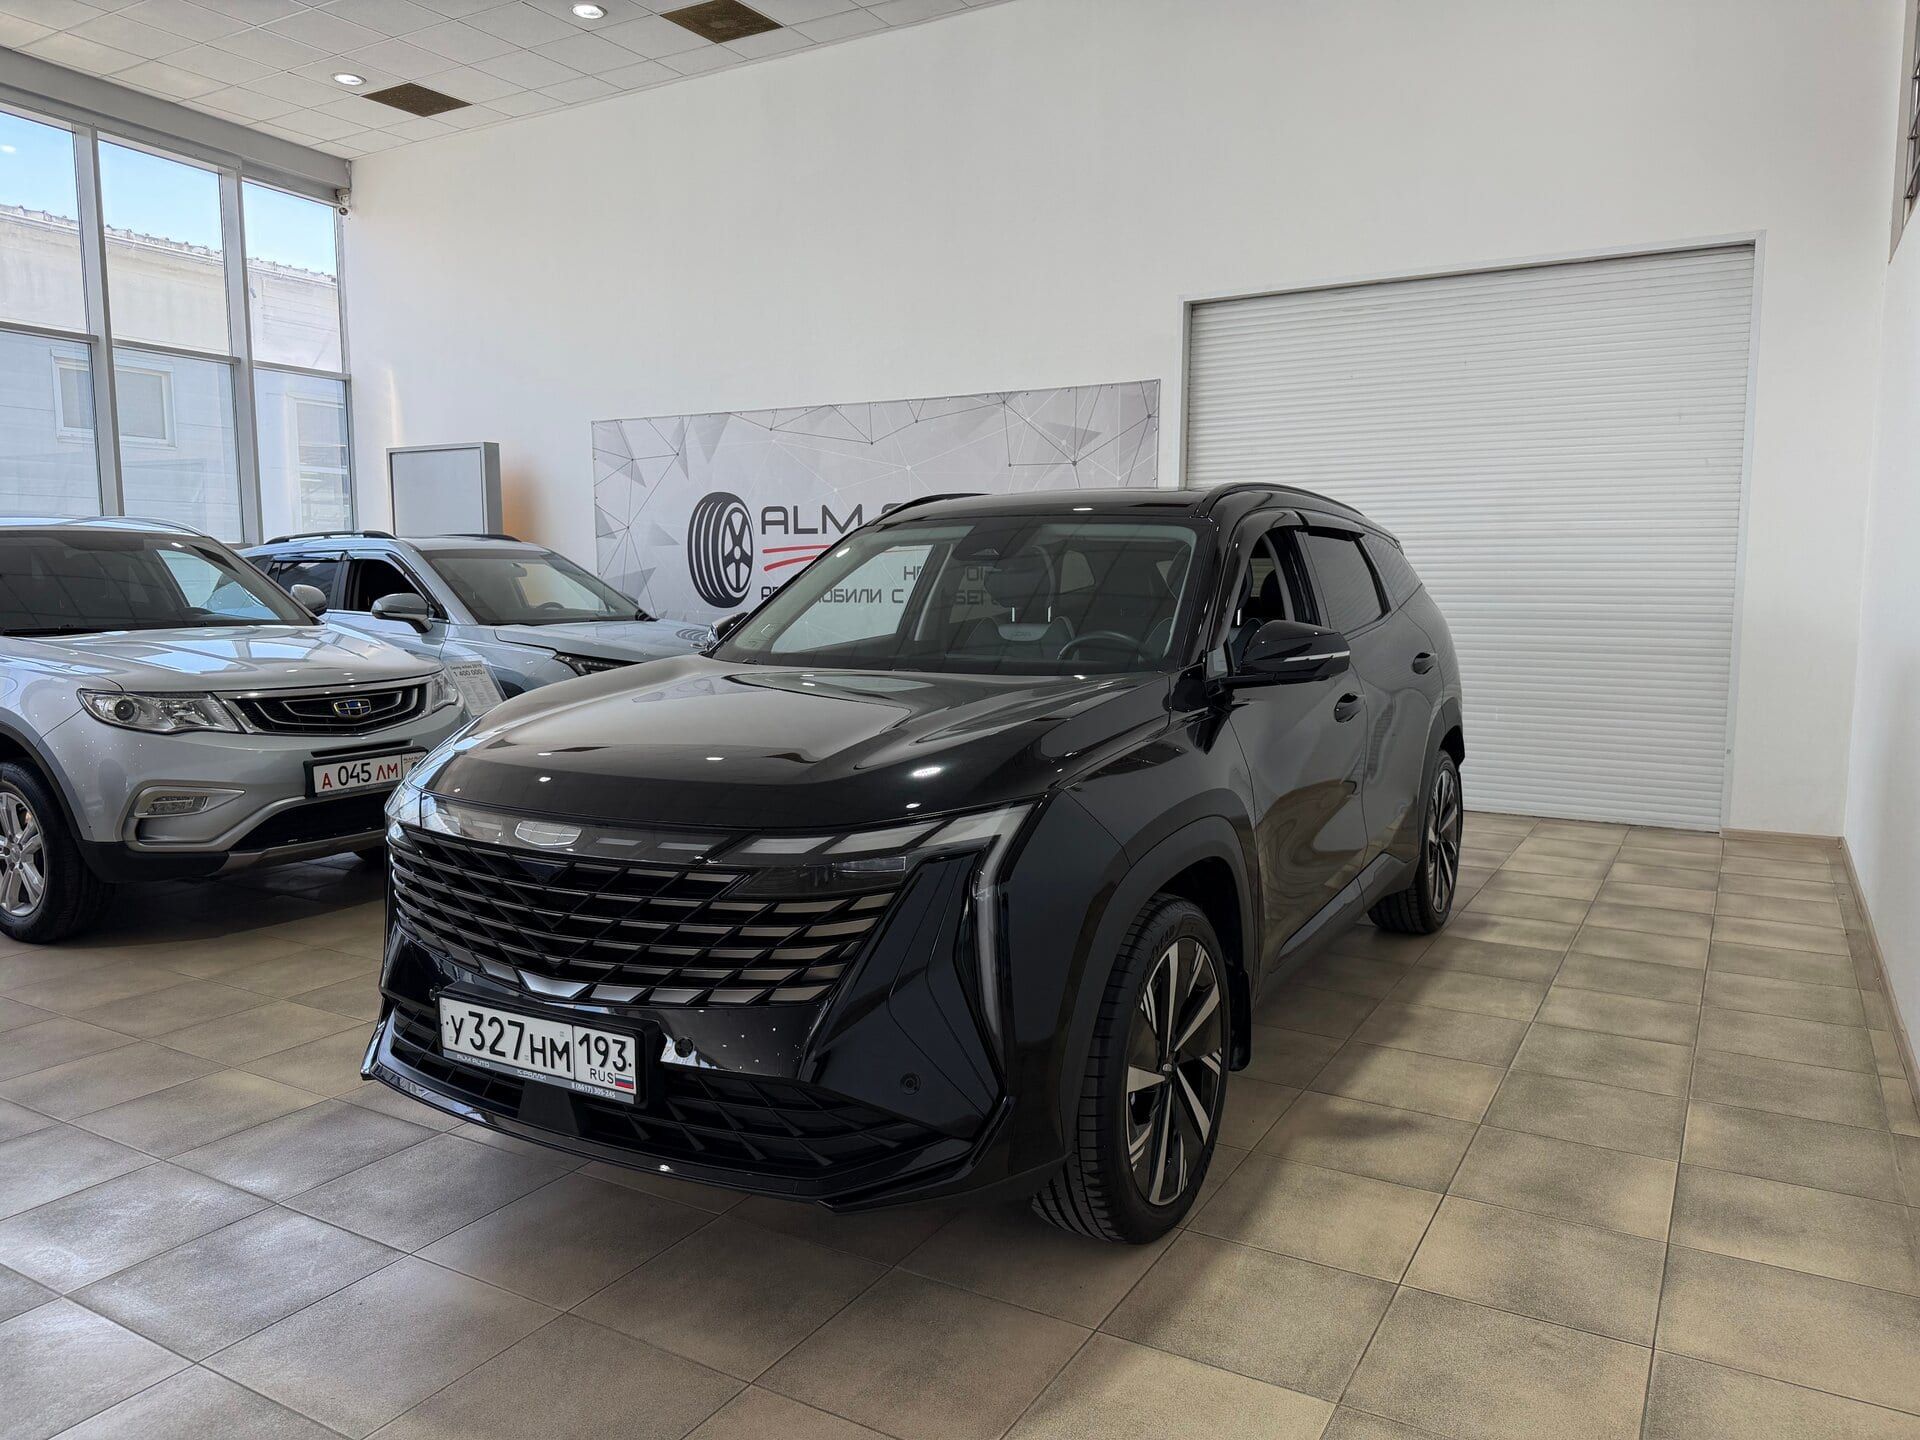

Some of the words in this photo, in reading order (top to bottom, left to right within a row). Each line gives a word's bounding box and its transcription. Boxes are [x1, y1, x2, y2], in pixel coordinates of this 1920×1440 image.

[761, 503, 863, 535] ALM
[761, 586, 882, 604] АОБИЛИ
[338, 762, 372, 786] 045
[578, 1032, 627, 1072] 193
[589, 1067, 614, 1084] RUS
